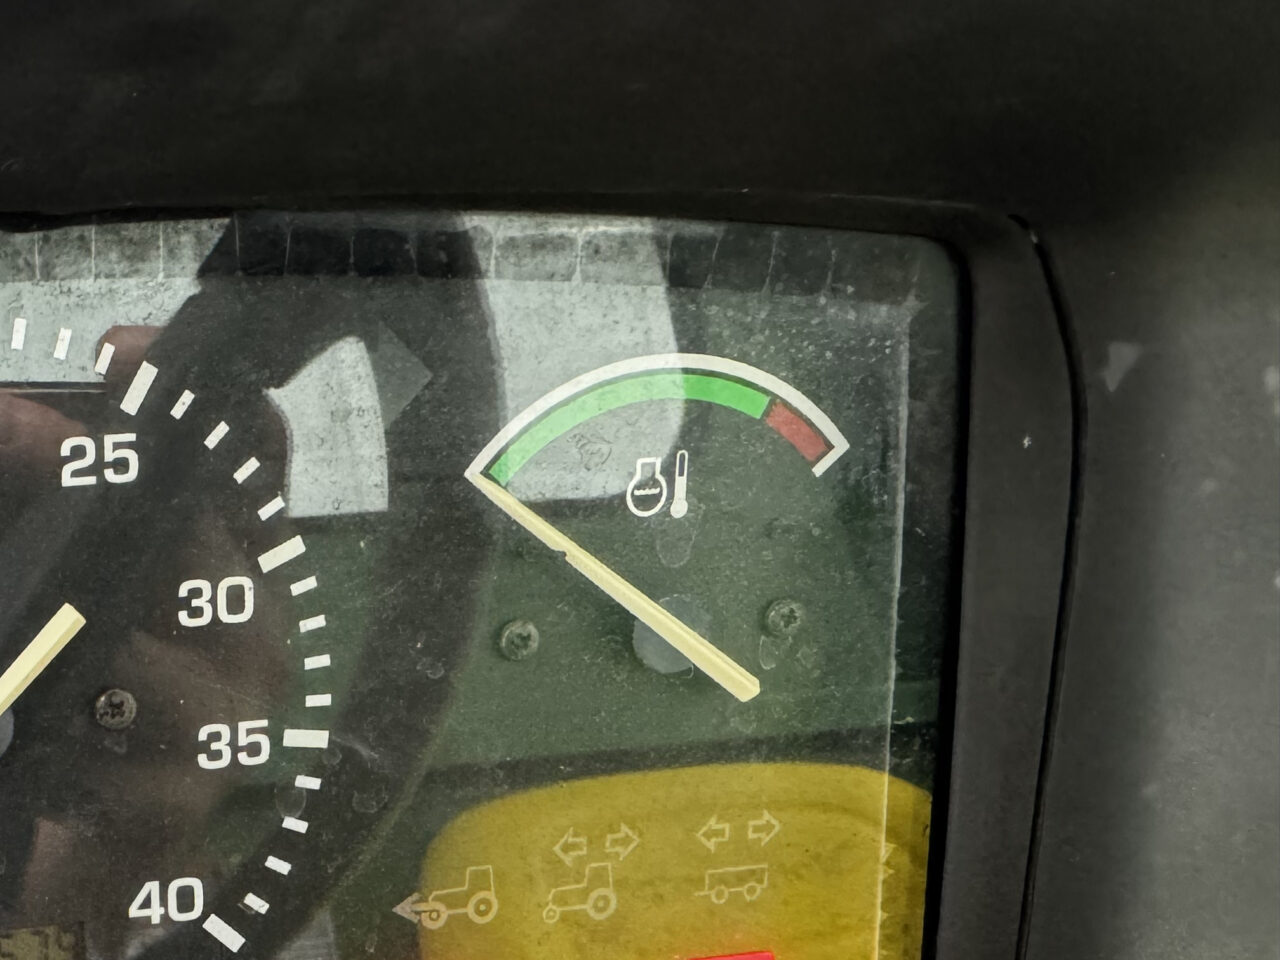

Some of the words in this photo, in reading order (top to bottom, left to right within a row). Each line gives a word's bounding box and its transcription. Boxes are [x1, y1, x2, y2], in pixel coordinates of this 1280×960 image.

[60, 433, 139, 487] 25
[177, 576, 255, 628] 30
[196, 719, 271, 770] 35
[128, 877, 204, 924] 40
